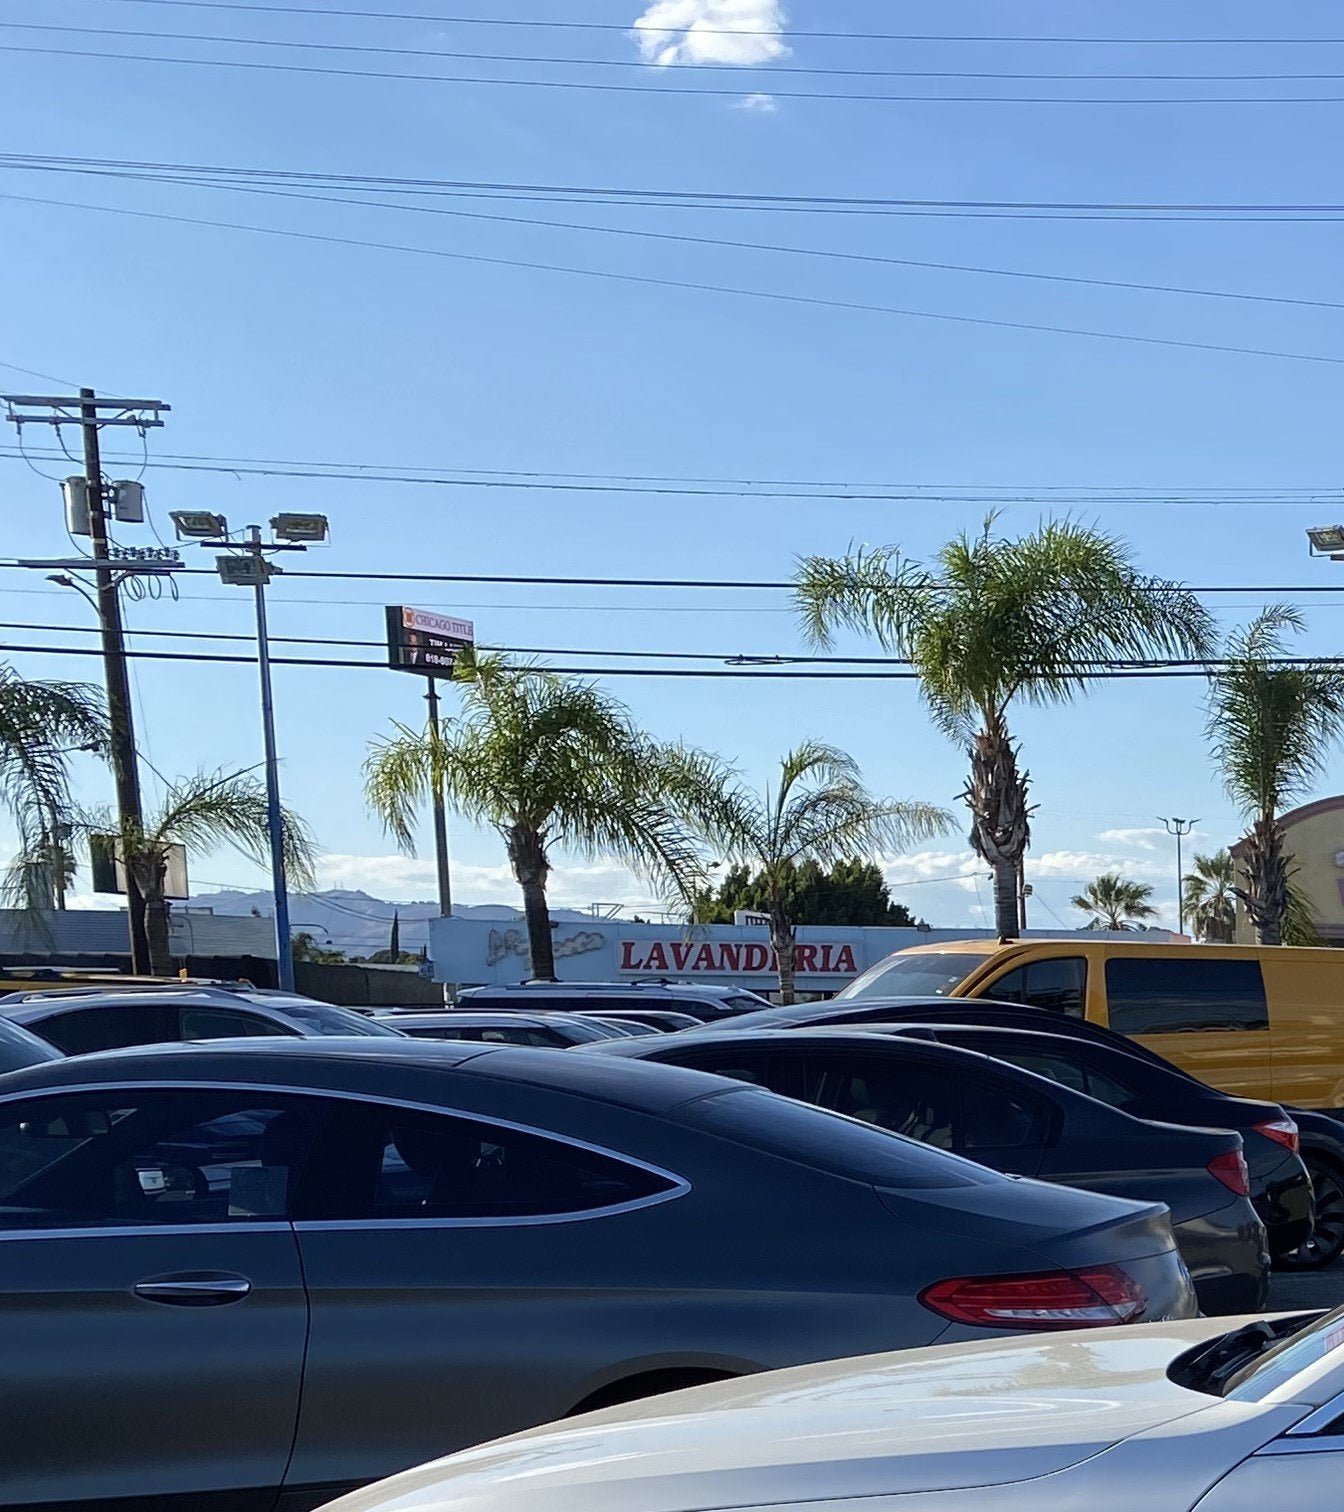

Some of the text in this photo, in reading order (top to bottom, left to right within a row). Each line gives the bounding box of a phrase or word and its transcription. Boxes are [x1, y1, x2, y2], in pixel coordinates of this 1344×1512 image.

[415, 614, 473, 636] CHICAGO TITLE
[620, 941, 858, 973] LAVANDRIA
